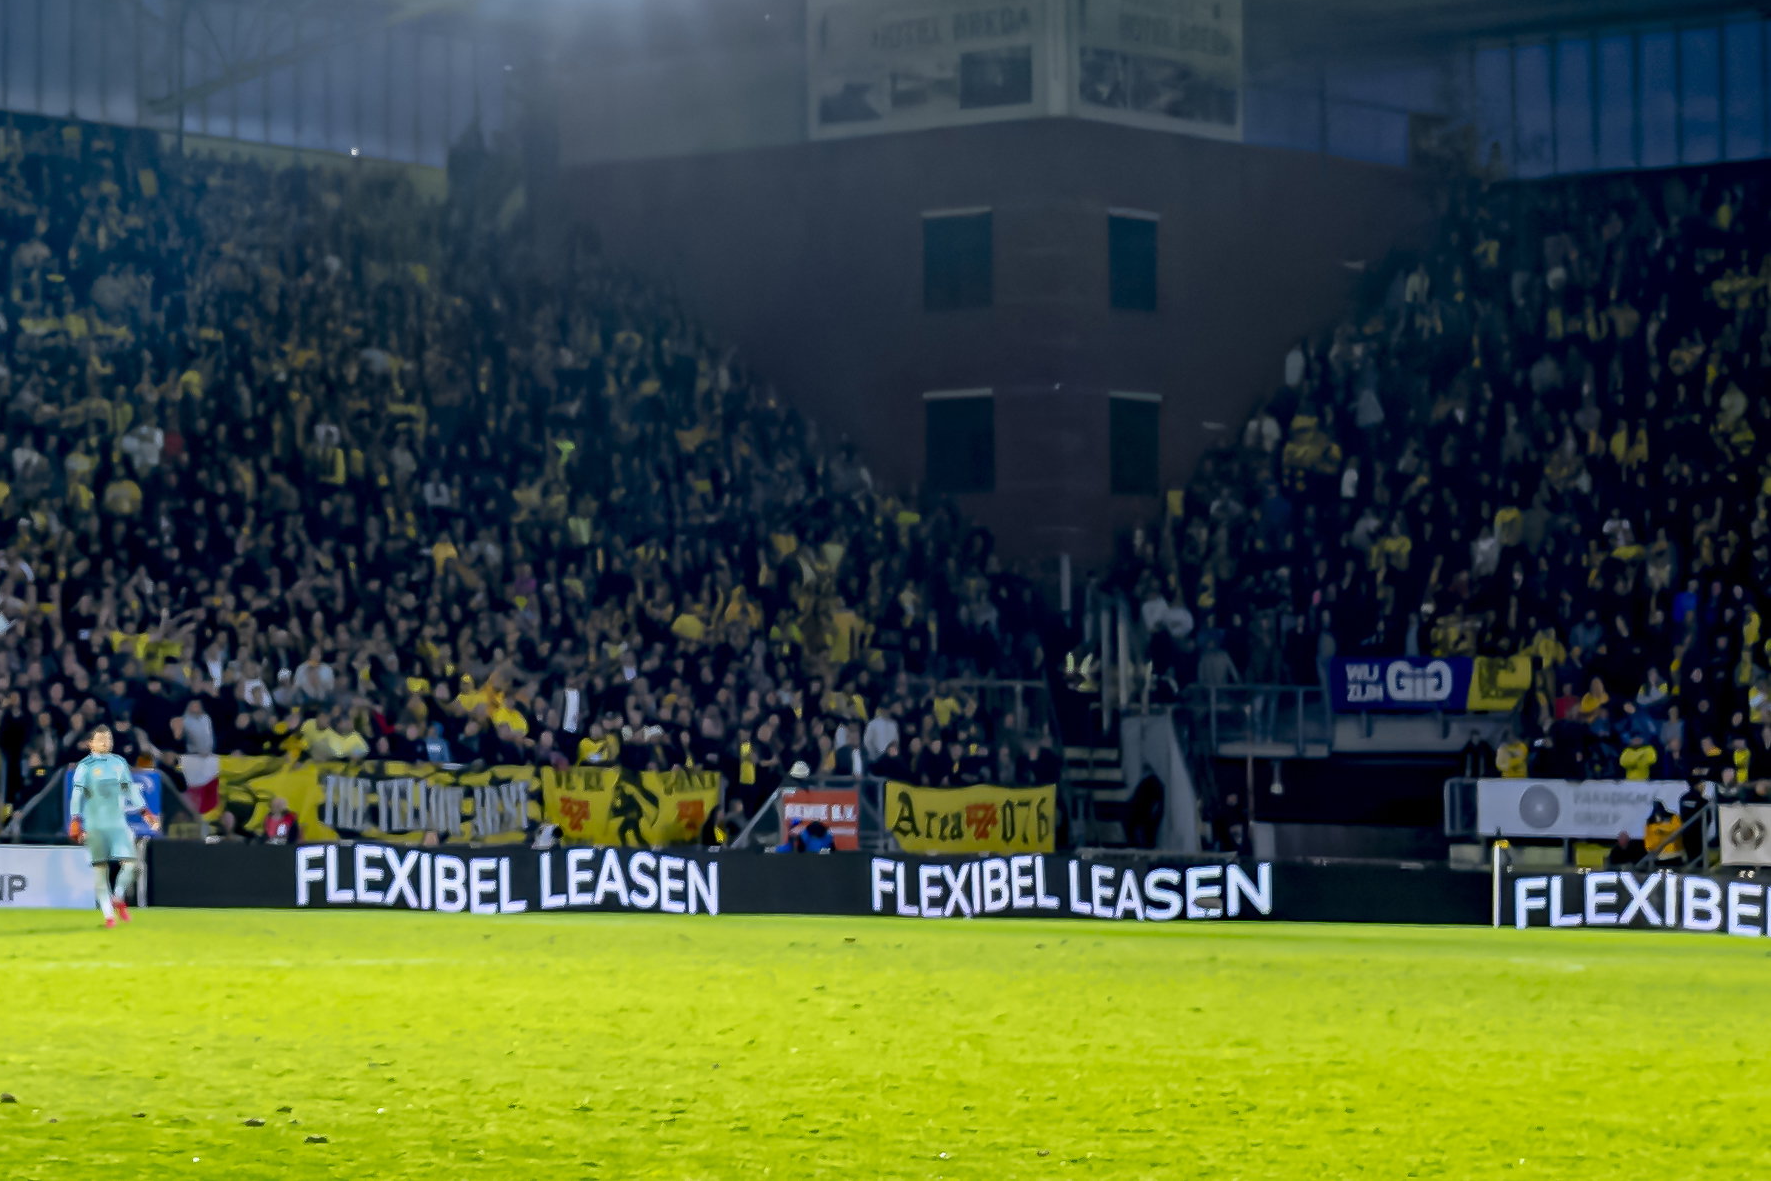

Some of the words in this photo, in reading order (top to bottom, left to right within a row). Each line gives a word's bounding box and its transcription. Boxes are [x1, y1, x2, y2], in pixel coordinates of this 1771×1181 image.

[891, 791, 964, 842] Area
[1001, 796, 1050, 844] 076
[296, 844, 526, 914] FLEXIBEL
[539, 848, 719, 916] LEASEN
[871, 855, 1060, 918] FLEXIBEL
[1068, 861, 1272, 921] LEASEN
[1515, 870, 1771, 938] FLEXIBE
